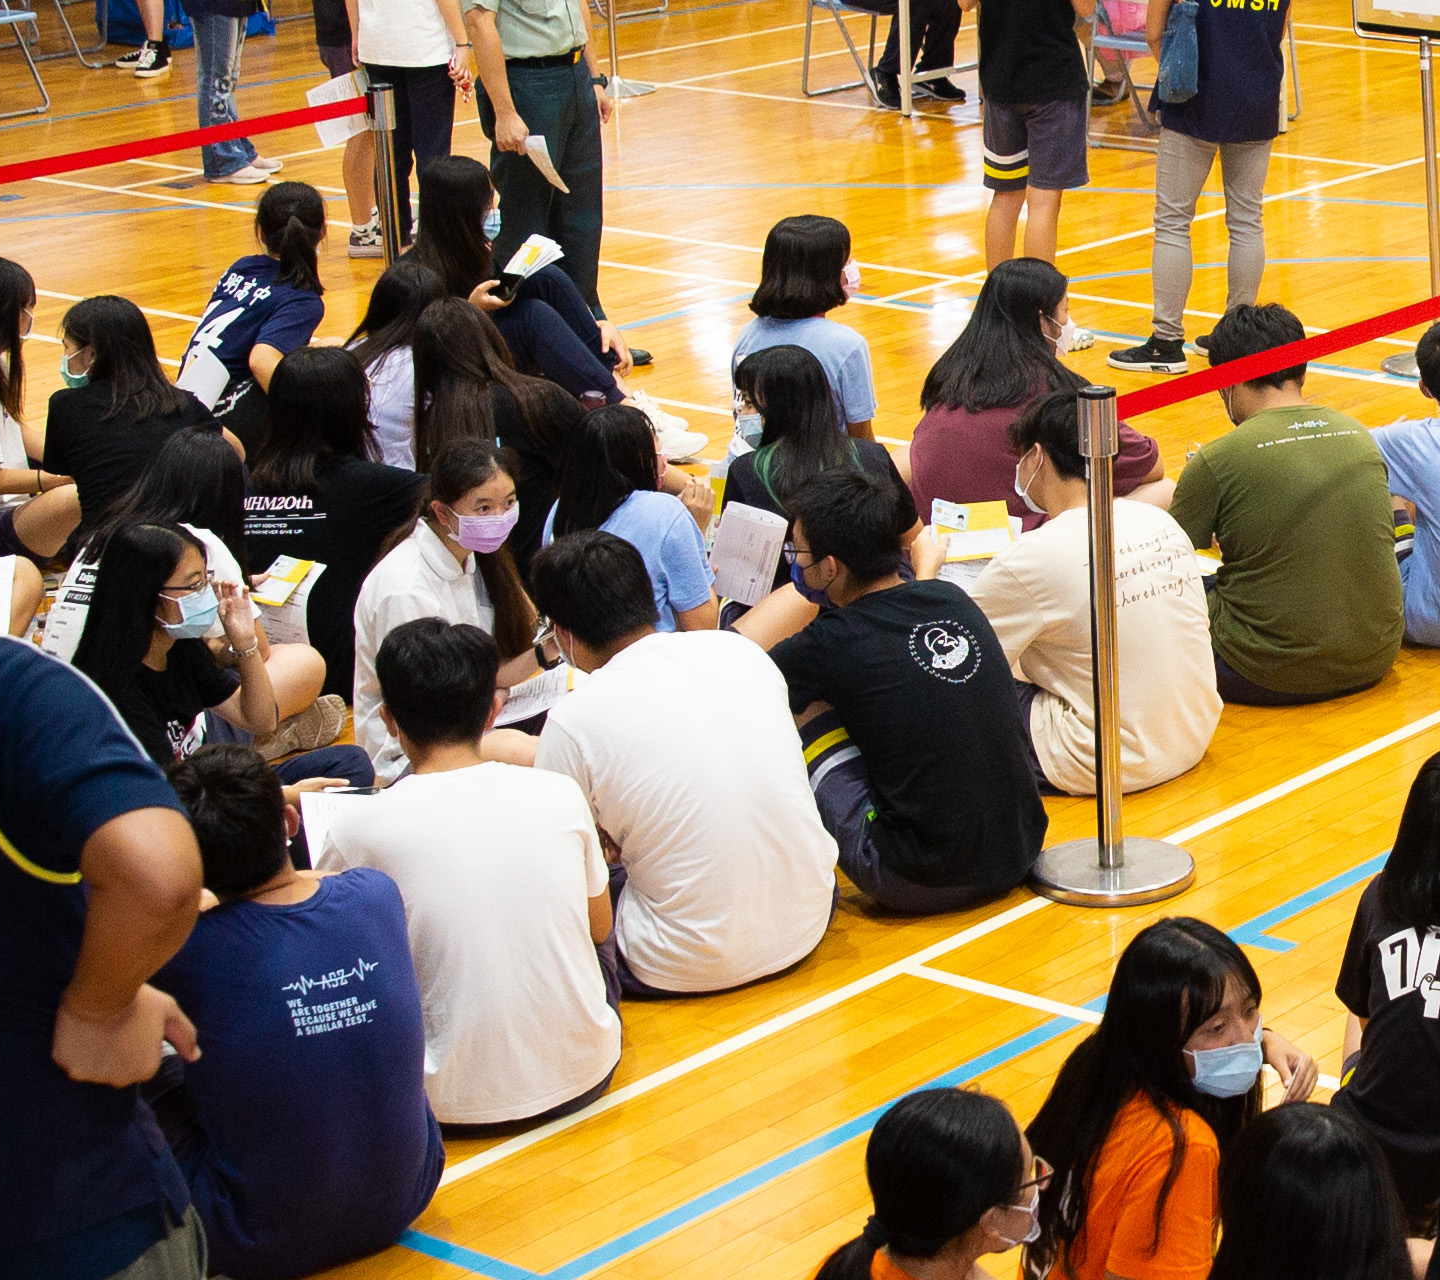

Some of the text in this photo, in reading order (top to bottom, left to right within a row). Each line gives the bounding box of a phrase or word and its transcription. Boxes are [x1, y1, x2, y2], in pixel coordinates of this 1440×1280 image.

[213, 270, 271, 307] 明高中
[287, 998, 302, 1009] WE
[291, 996, 359, 1017] ARE TOGETHER
[294, 999, 378, 1027] BECAUSE WE HAVE
[296, 1027, 304, 1037] A
[306, 1019, 344, 1036] SIMILAR
